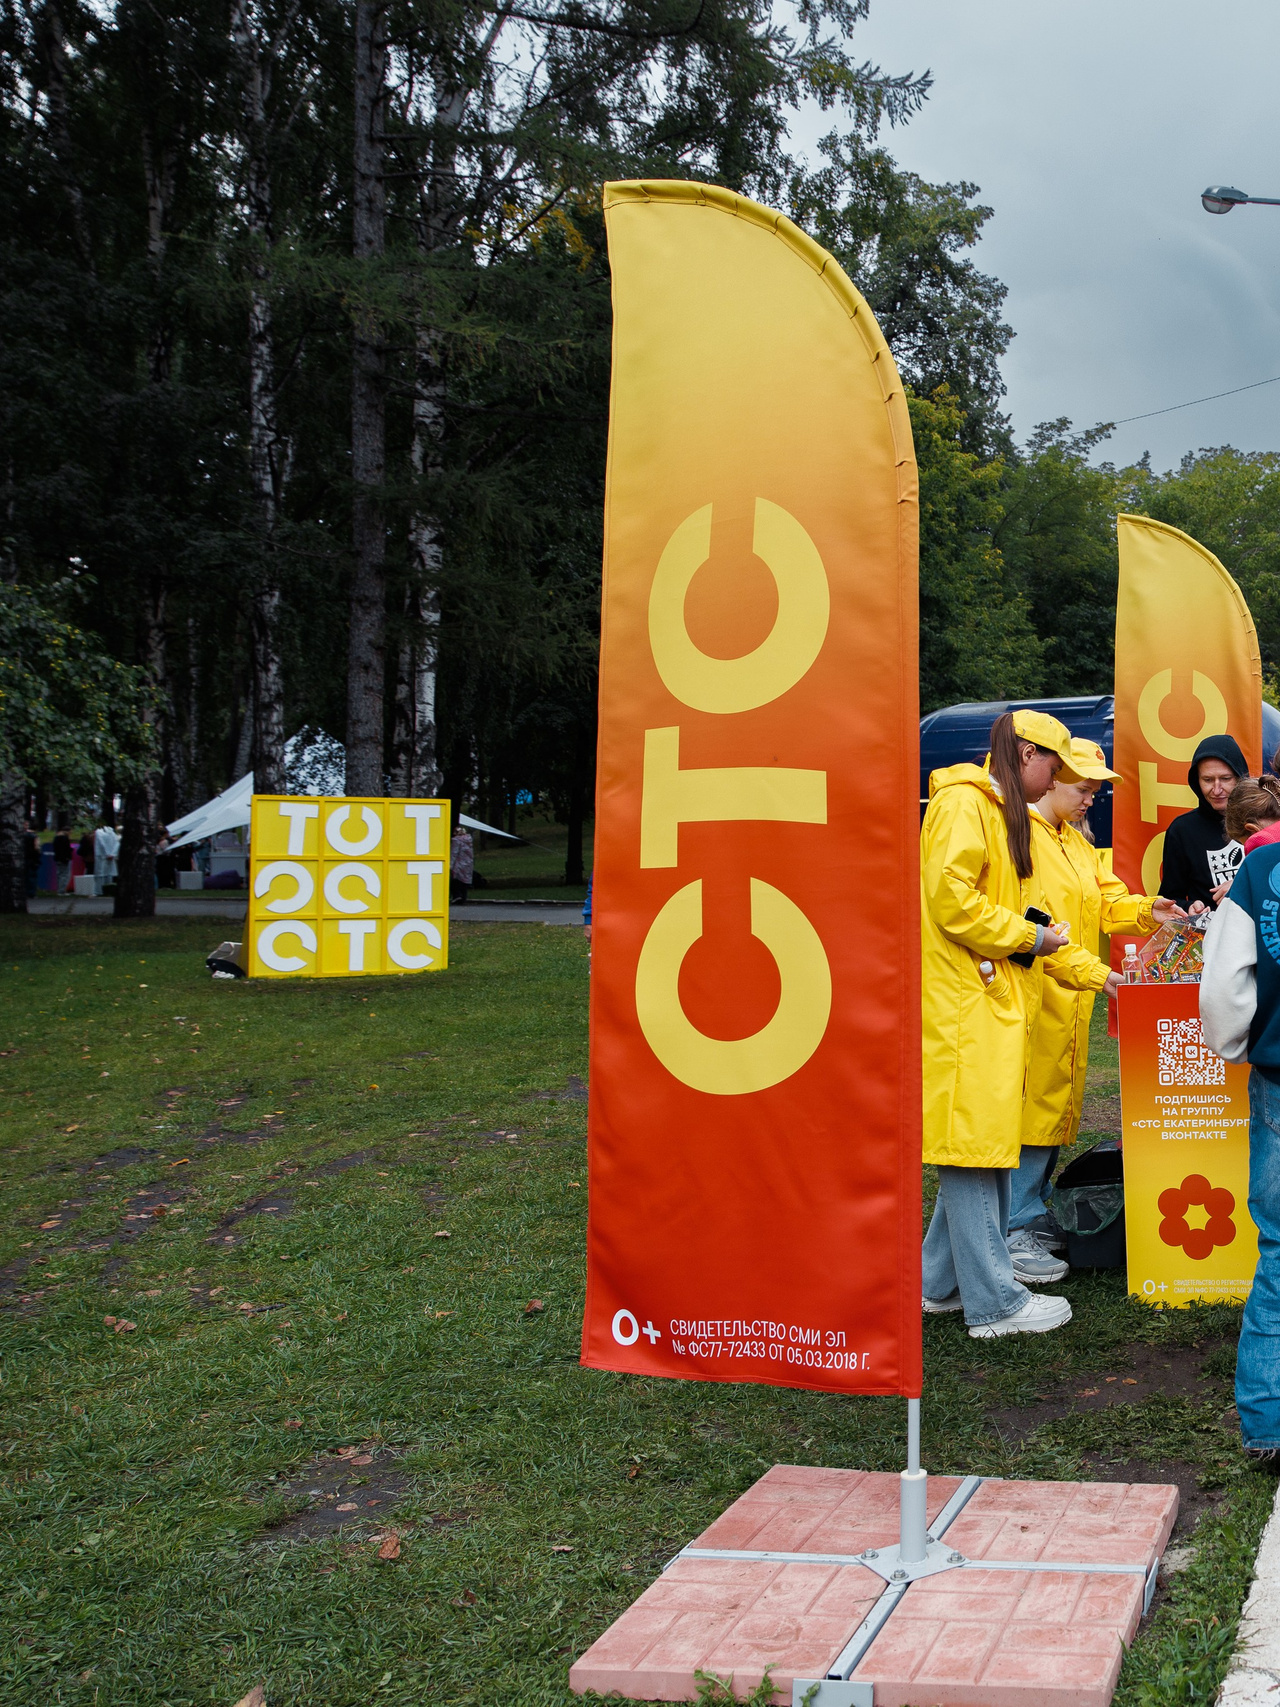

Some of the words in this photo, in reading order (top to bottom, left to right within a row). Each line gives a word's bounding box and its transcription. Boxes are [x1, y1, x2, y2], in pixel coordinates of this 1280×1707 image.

[635, 496, 832, 1096] СТС
[1154, 1095, 1232, 1105] ПОДПИШИСЬ
[1162, 1107, 1178, 1116] НА
[1181, 1107, 1225, 1116] ГРУППУ
[1131, 1119, 1161, 1129] «СТС
[1163, 1118, 1250, 1128] ЕКАТЕРИНБУРГ
[1161, 1131, 1227, 1140] ВКОНТАКТЕ
[670, 1319, 786, 1340] СВИДЕТЕЛЬСТВО
[789, 1325, 820, 1346] СМИ
[825, 1331, 846, 1347] ЭЛ
[672, 1339, 686, 1355] №
[688, 1341, 766, 1358] ФС77-72433
[769, 1343, 784, 1361] ОТ
[787, 1347, 857, 1370] 05.03.2018
[861, 1353, 870, 1370] Г.
